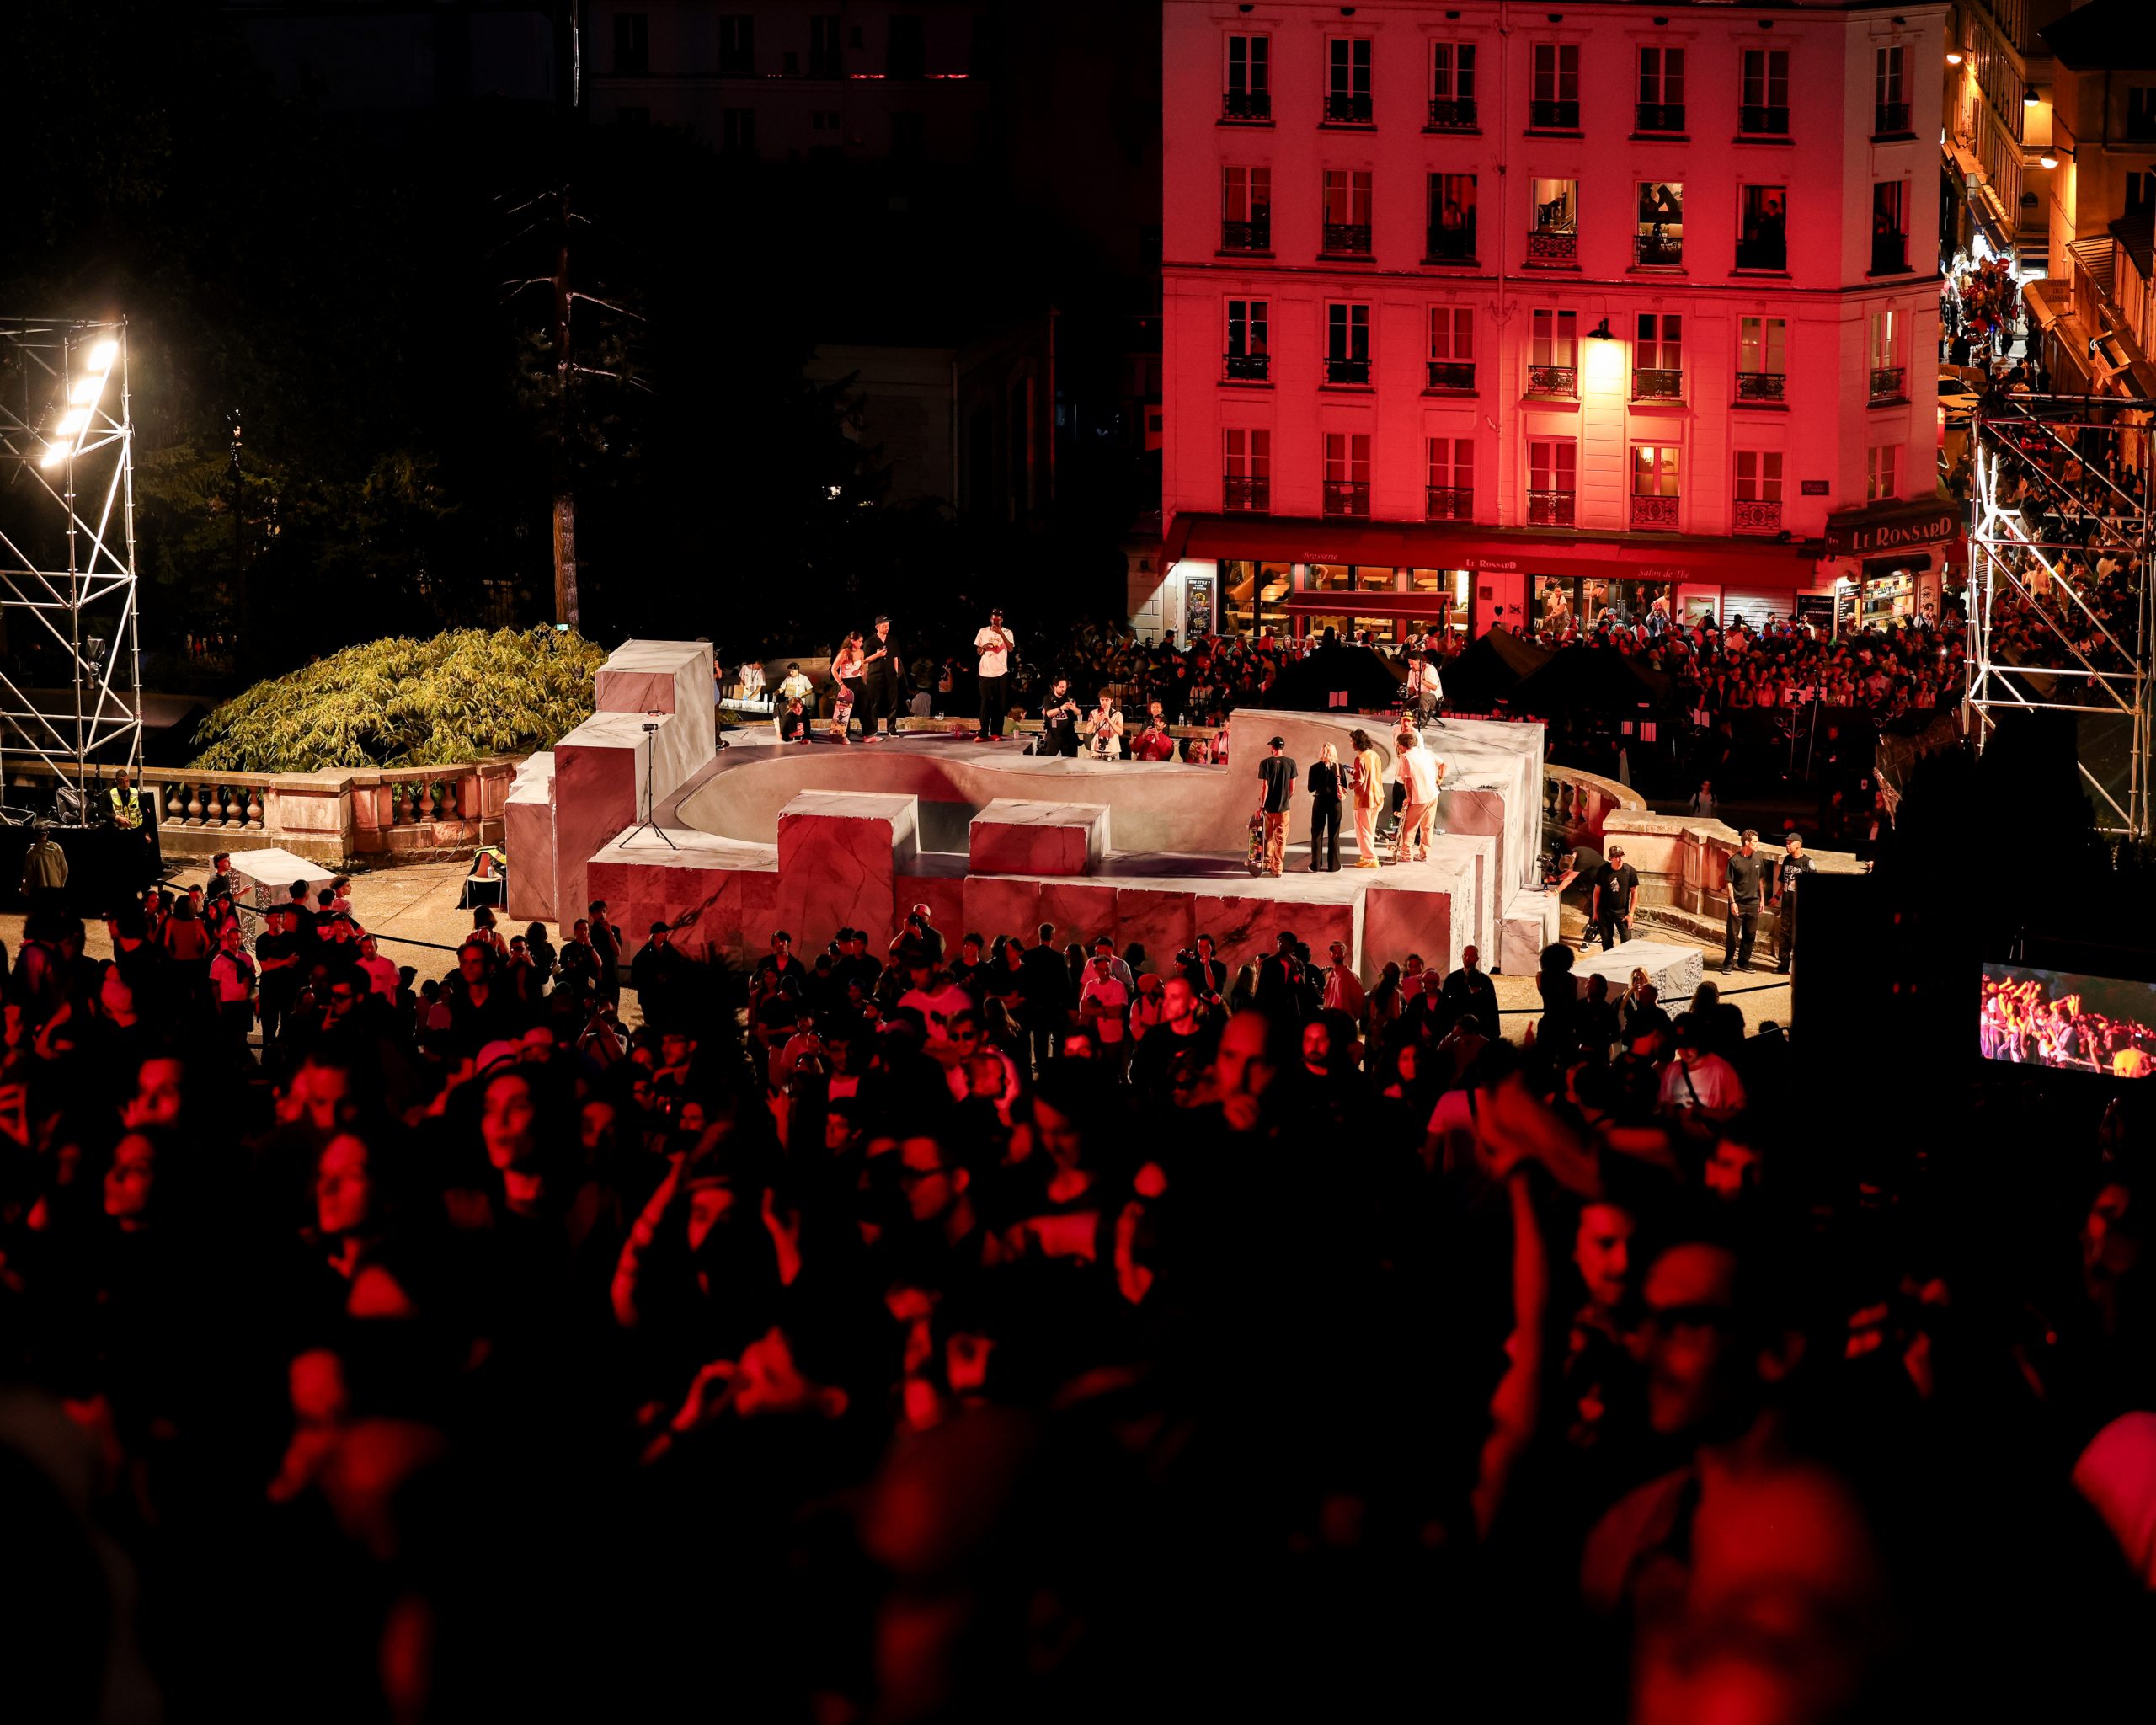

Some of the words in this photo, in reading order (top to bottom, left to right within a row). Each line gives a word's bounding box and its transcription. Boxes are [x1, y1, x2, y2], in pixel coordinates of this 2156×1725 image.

[1853, 531, 1870, 550] LE
[1876, 517, 1951, 547] RONSARD
[1303, 551, 1338, 560] Brasserie
[1638, 568, 1661, 577] Salon
[1662, 569, 1673, 578] de
